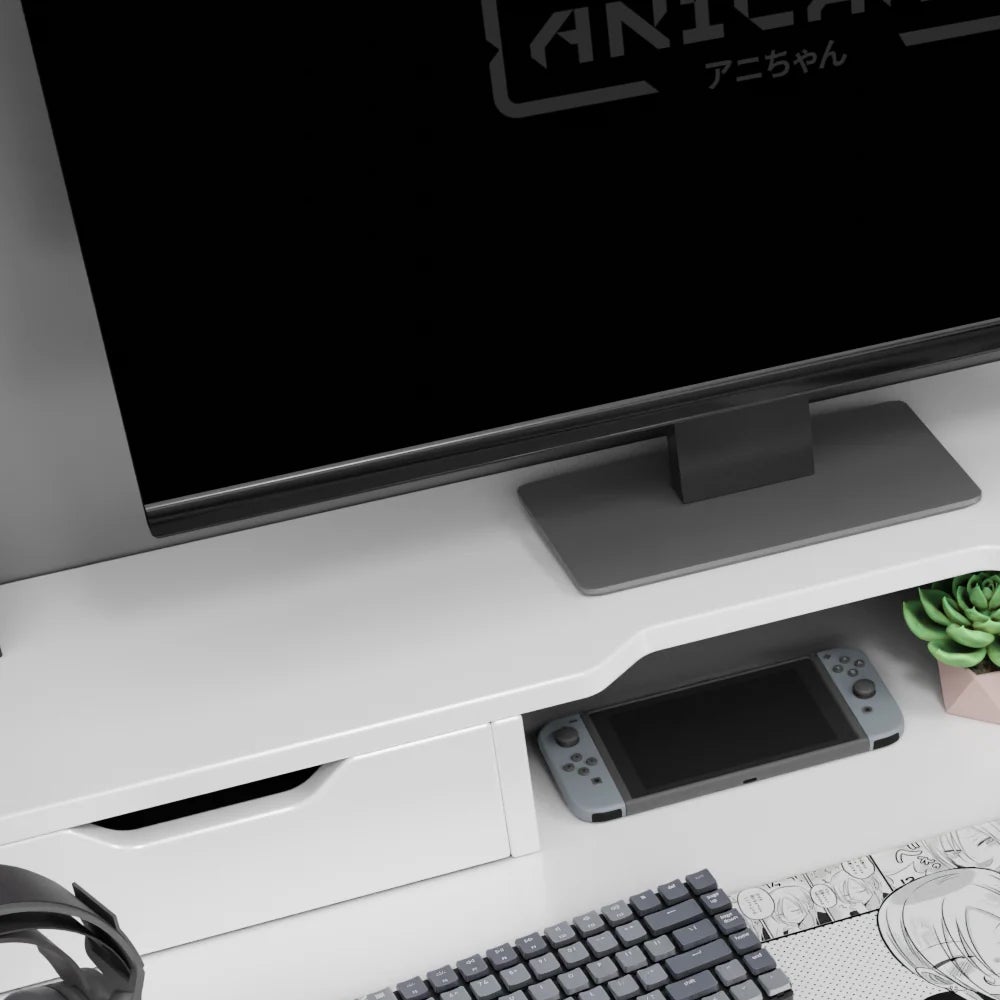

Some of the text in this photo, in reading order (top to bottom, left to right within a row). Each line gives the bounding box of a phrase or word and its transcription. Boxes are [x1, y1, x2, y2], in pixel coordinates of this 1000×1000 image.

[705, 40, 848, 90] アニちゃん
